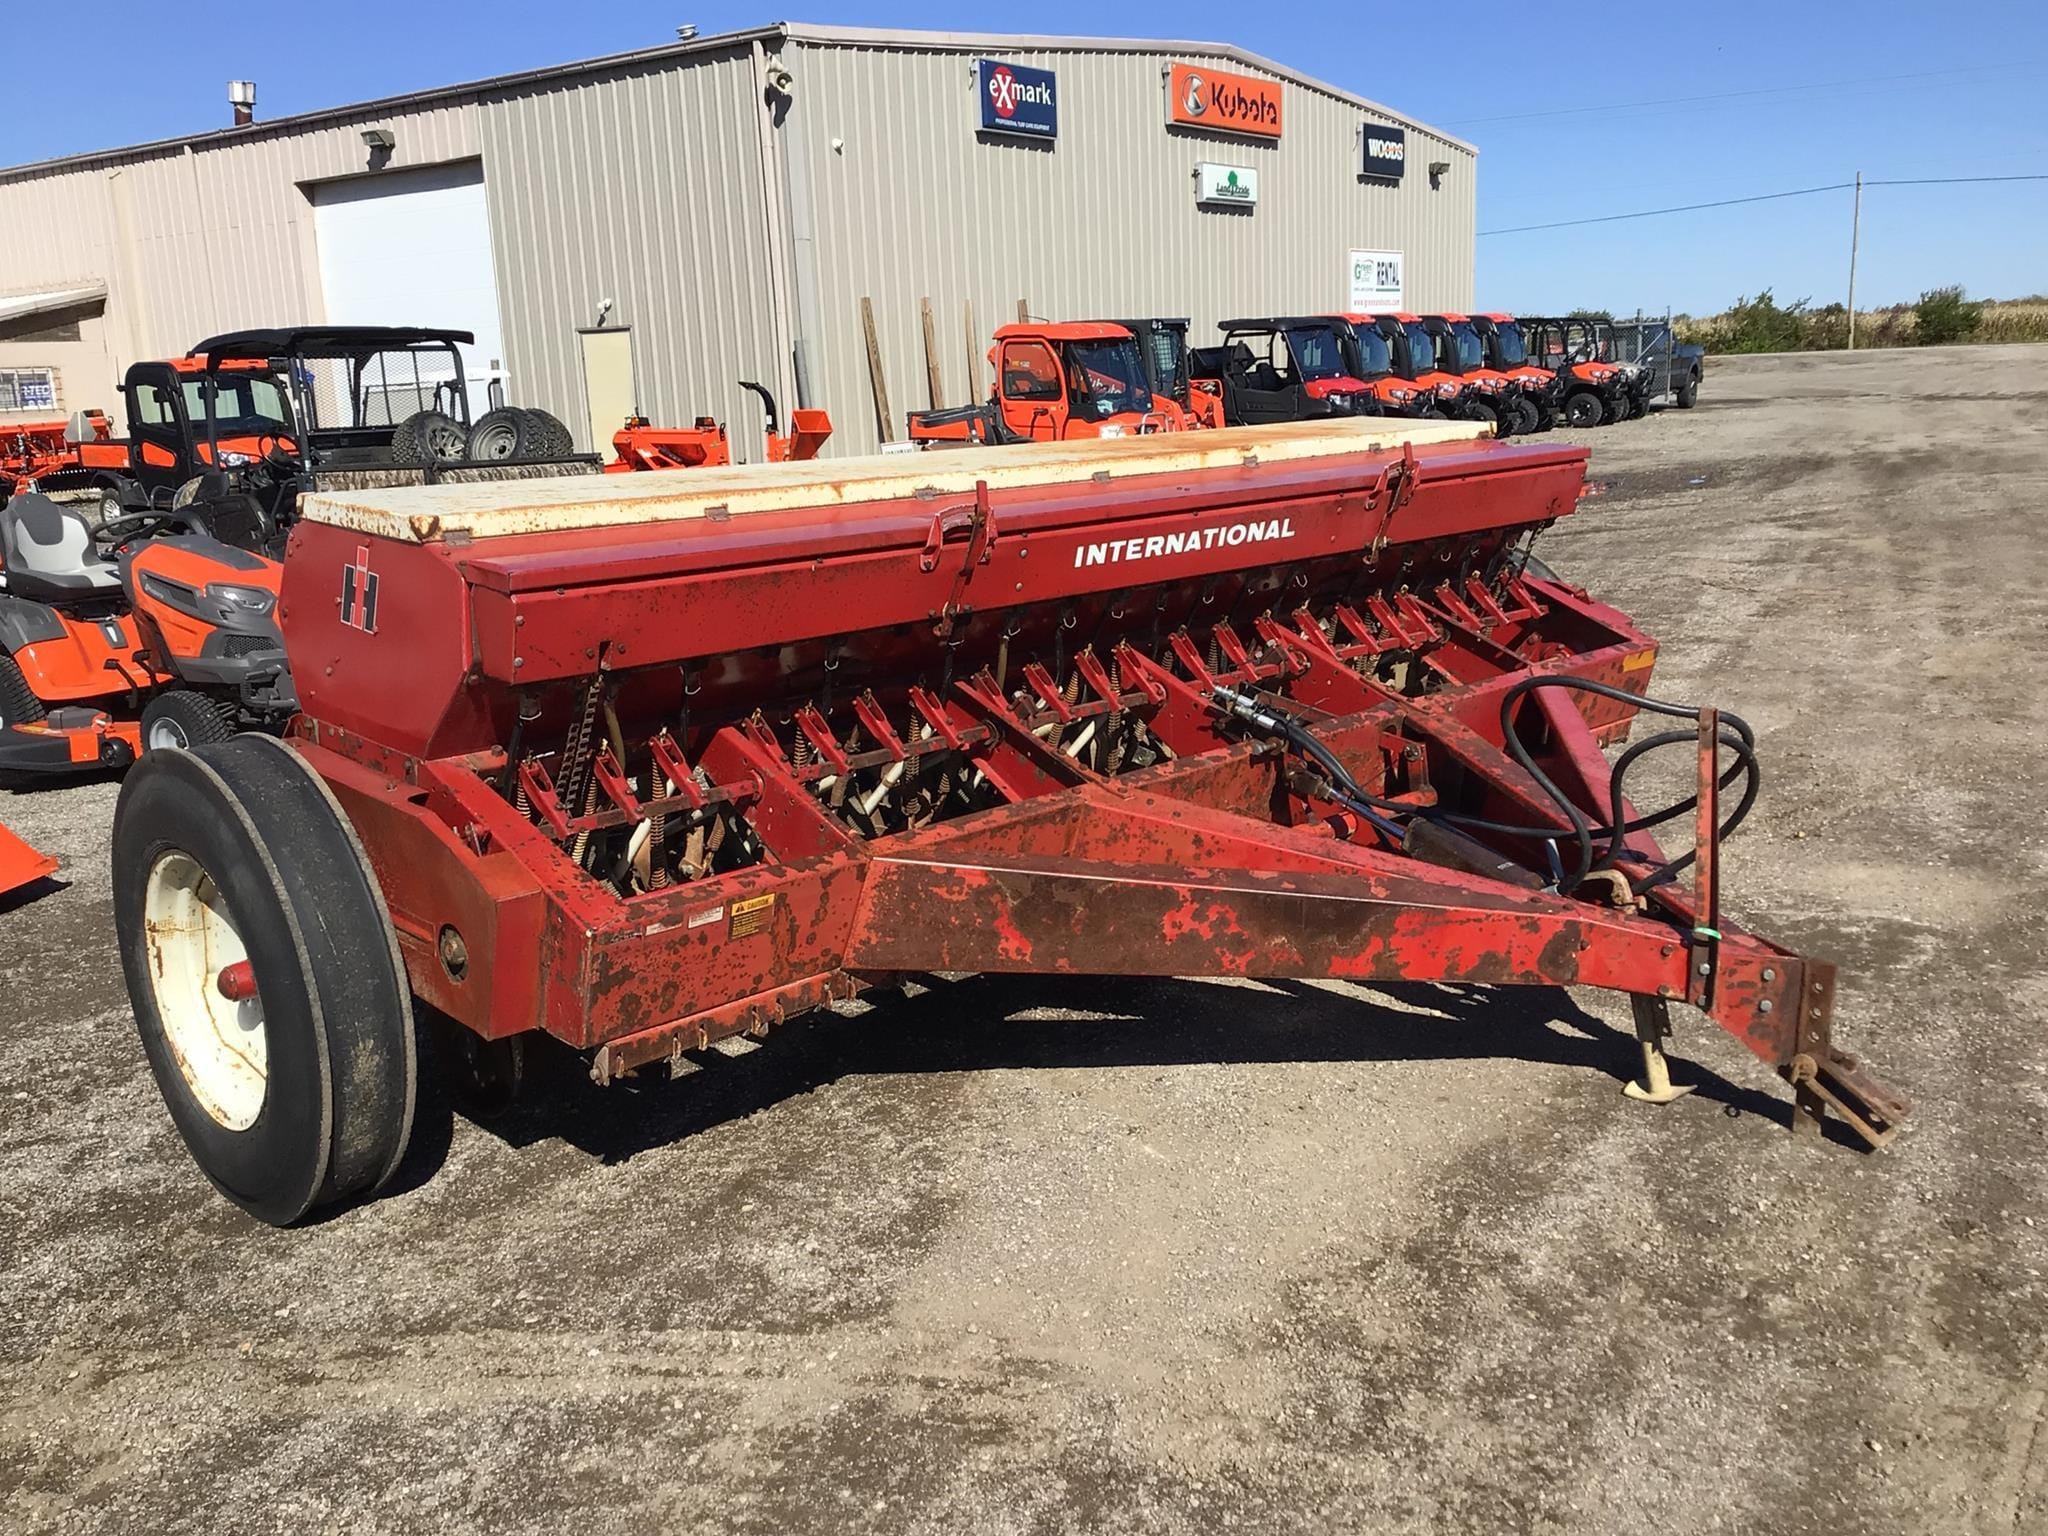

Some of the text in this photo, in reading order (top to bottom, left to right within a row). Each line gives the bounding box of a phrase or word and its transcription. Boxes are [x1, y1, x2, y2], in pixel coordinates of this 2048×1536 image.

[1211, 82, 1277, 125] Kubota
[1368, 138, 1404, 161] WOODS
[1376, 261, 1400, 286] RENTAL
[1074, 518, 1295, 568] INTERNATIONAL
